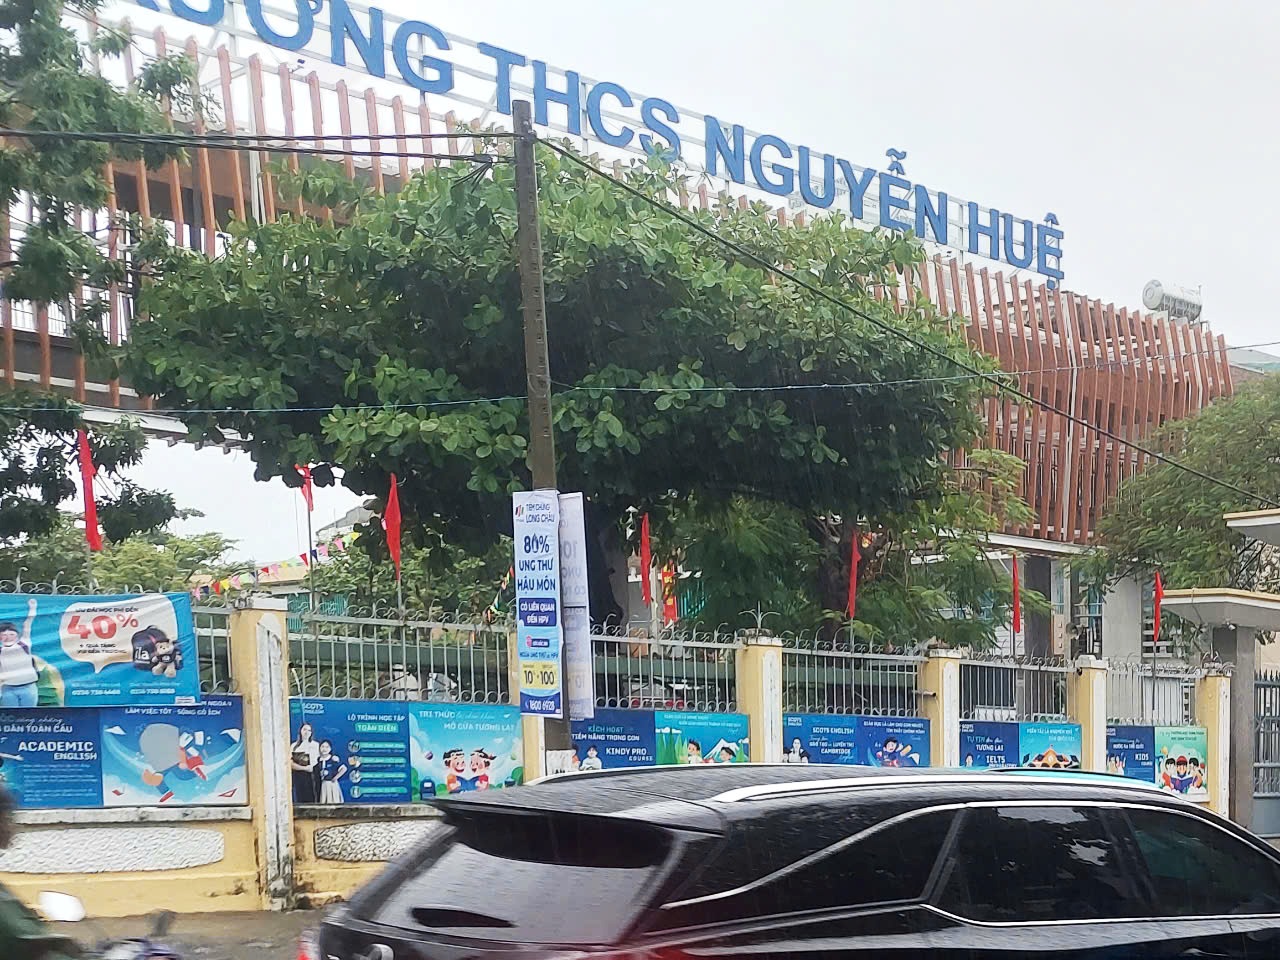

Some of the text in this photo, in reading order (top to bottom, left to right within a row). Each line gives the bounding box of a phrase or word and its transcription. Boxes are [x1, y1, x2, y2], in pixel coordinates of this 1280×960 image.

[477, 42, 682, 163] THCS
[703, 115, 948, 247] NGUYỄN
[968, 202, 1065, 289] HUỆ
[526, 514, 540, 523] LONG
[524, 533, 550, 554] 80%
[519, 557, 554, 571] UNG THƯ
[517, 575, 556, 594] HẬU MÔN
[539, 615, 549, 624] HPV
[67, 614, 138, 640] 40%
[18, 741, 94, 752] ACADEMIC
[606, 747, 647, 756] KINDY PRO
[53, 752, 97, 760] ENGLISH
